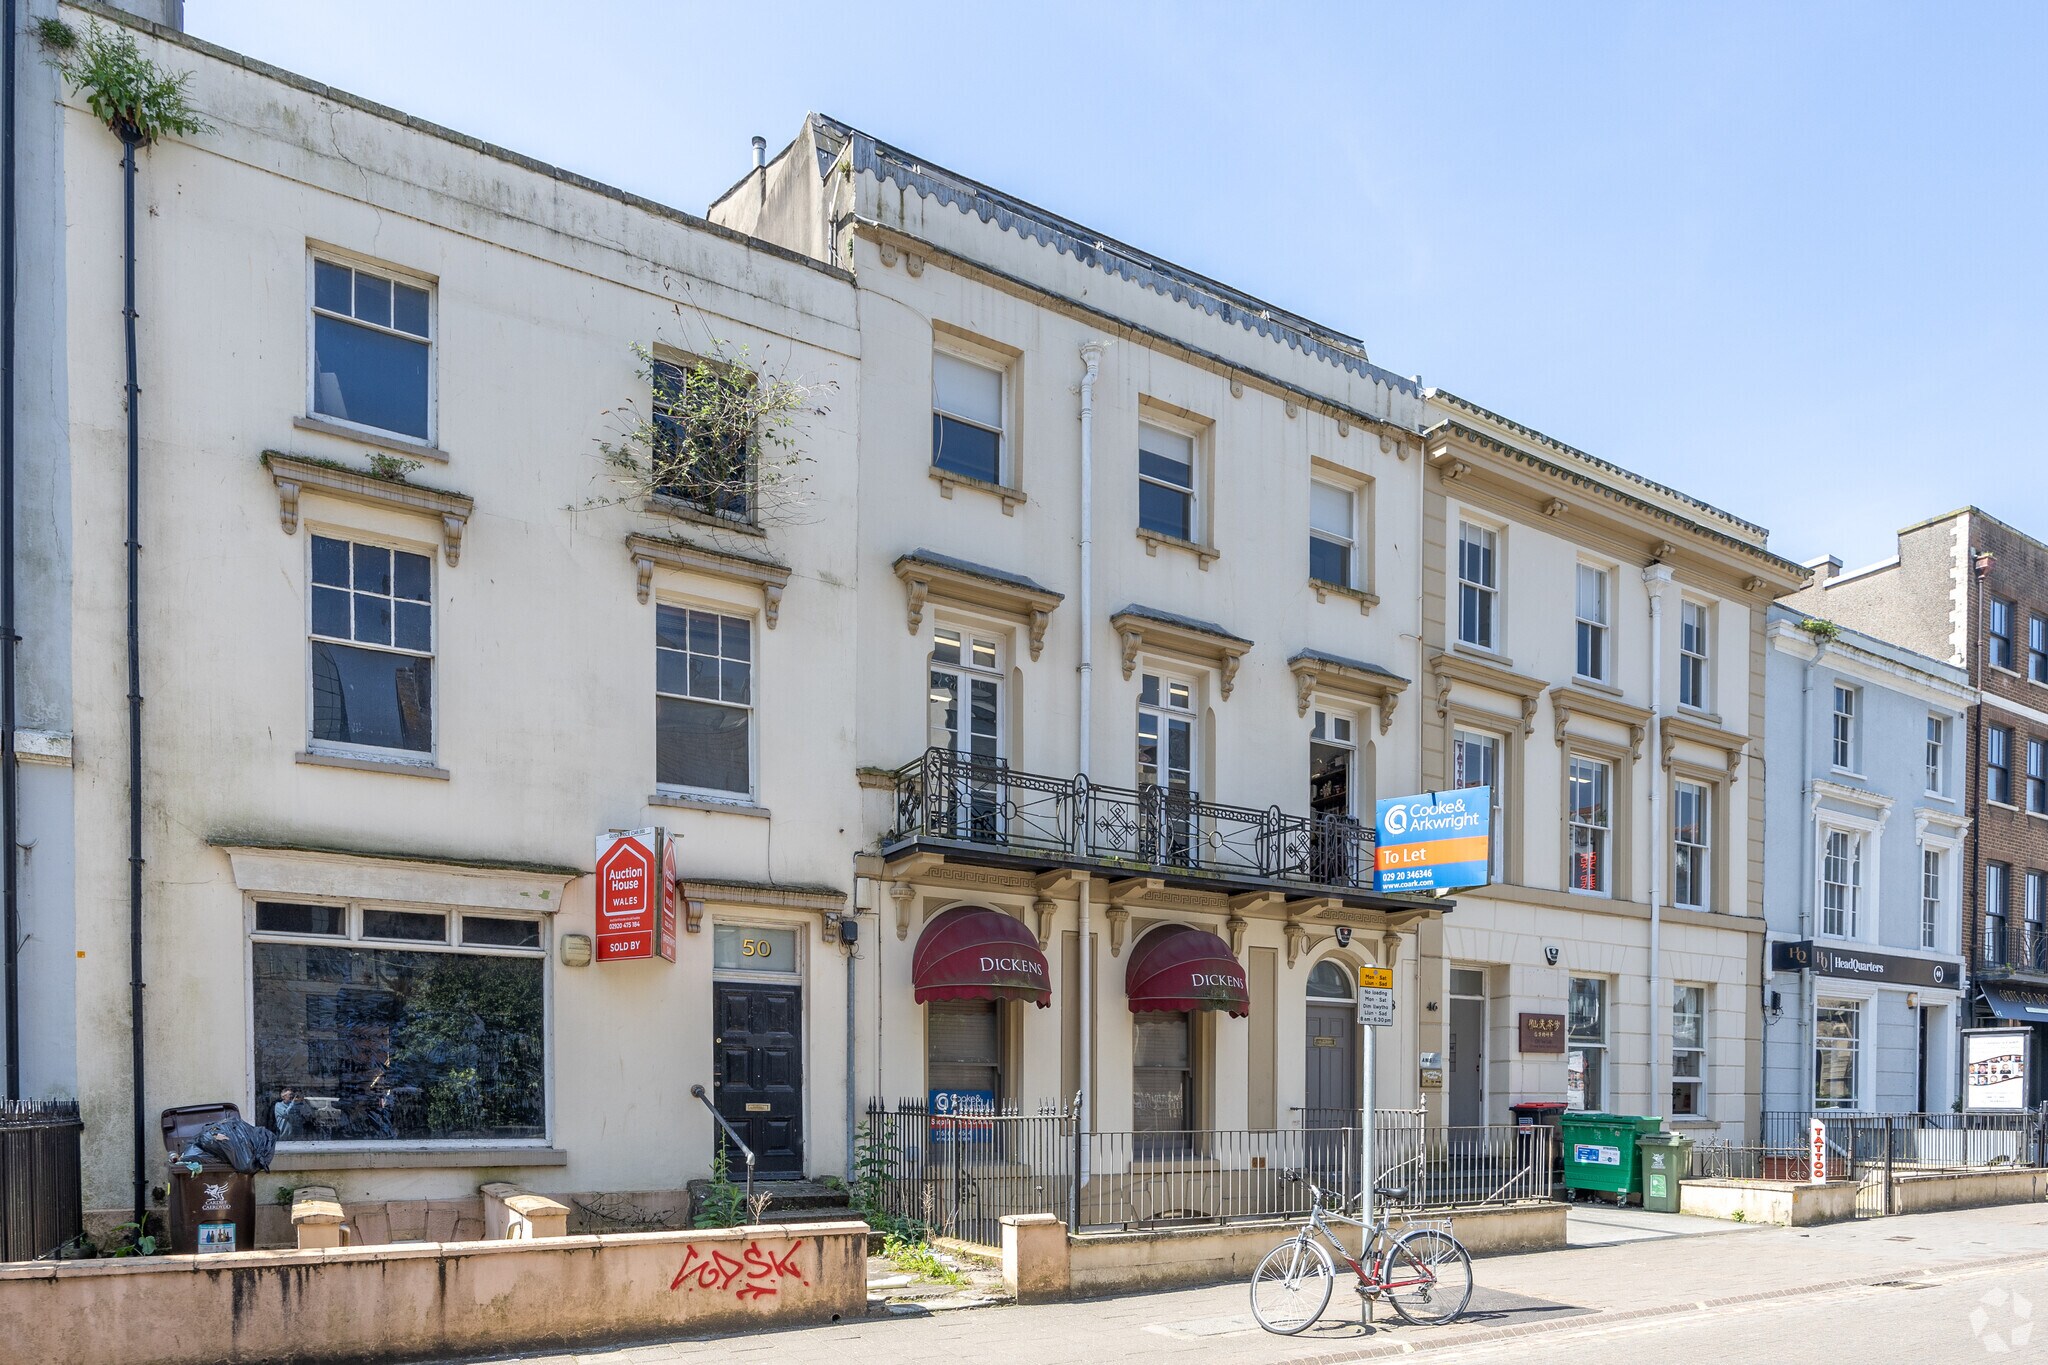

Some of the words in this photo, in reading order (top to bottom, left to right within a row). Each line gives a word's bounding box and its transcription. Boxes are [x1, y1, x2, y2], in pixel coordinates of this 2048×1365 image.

[1410, 799, 1466, 818] Cooke&
[1410, 812, 1479, 832] Arkwright
[1383, 850, 1399, 864] To
[1403, 848, 1427, 862] Let
[609, 867, 642, 880] Auction
[1382, 872, 1395, 881] 029
[1396, 871, 1405, 880] 20
[1406, 869, 1432, 879] 346346
[612, 880, 638, 891] House
[1382, 879, 1434, 889] www.coark.com
[613, 896, 638, 906] WALES
[610, 942, 629, 952] SOLD
[630, 941, 640, 950] BY
[742, 939, 771, 957] 50
[1789, 946, 1807, 964] HQ
[1816, 951, 1828, 972] HQ
[1834, 956, 1884, 973] HeadQuarters
[980, 957, 1043, 976] DICKENS
[1191, 973, 1244, 990] DICKENS
[1426, 1001, 1438, 1012] 46
[1813, 1128, 1824, 1178] TATTOO
